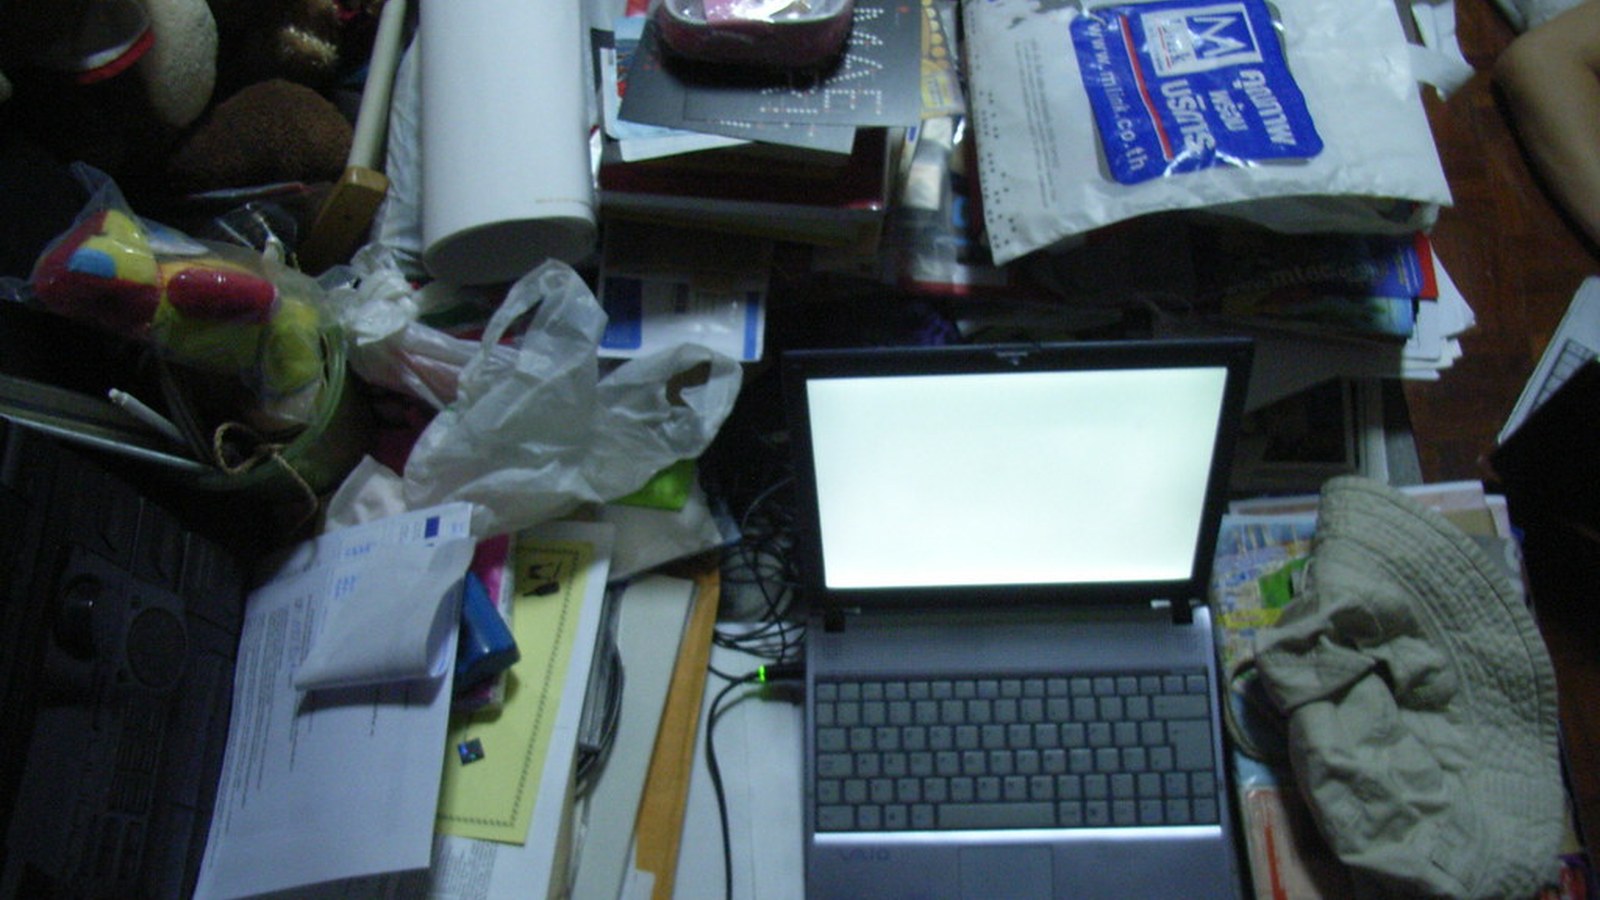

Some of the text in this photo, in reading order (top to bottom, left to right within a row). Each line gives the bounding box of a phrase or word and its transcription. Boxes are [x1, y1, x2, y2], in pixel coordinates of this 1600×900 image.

[1160, 78, 1217, 154] บริการ
[1208, 90, 1249, 131] พร้อม
[1231, 69, 1297, 146] คุณภาพ
[833, 847, 891, 861] VAIO
